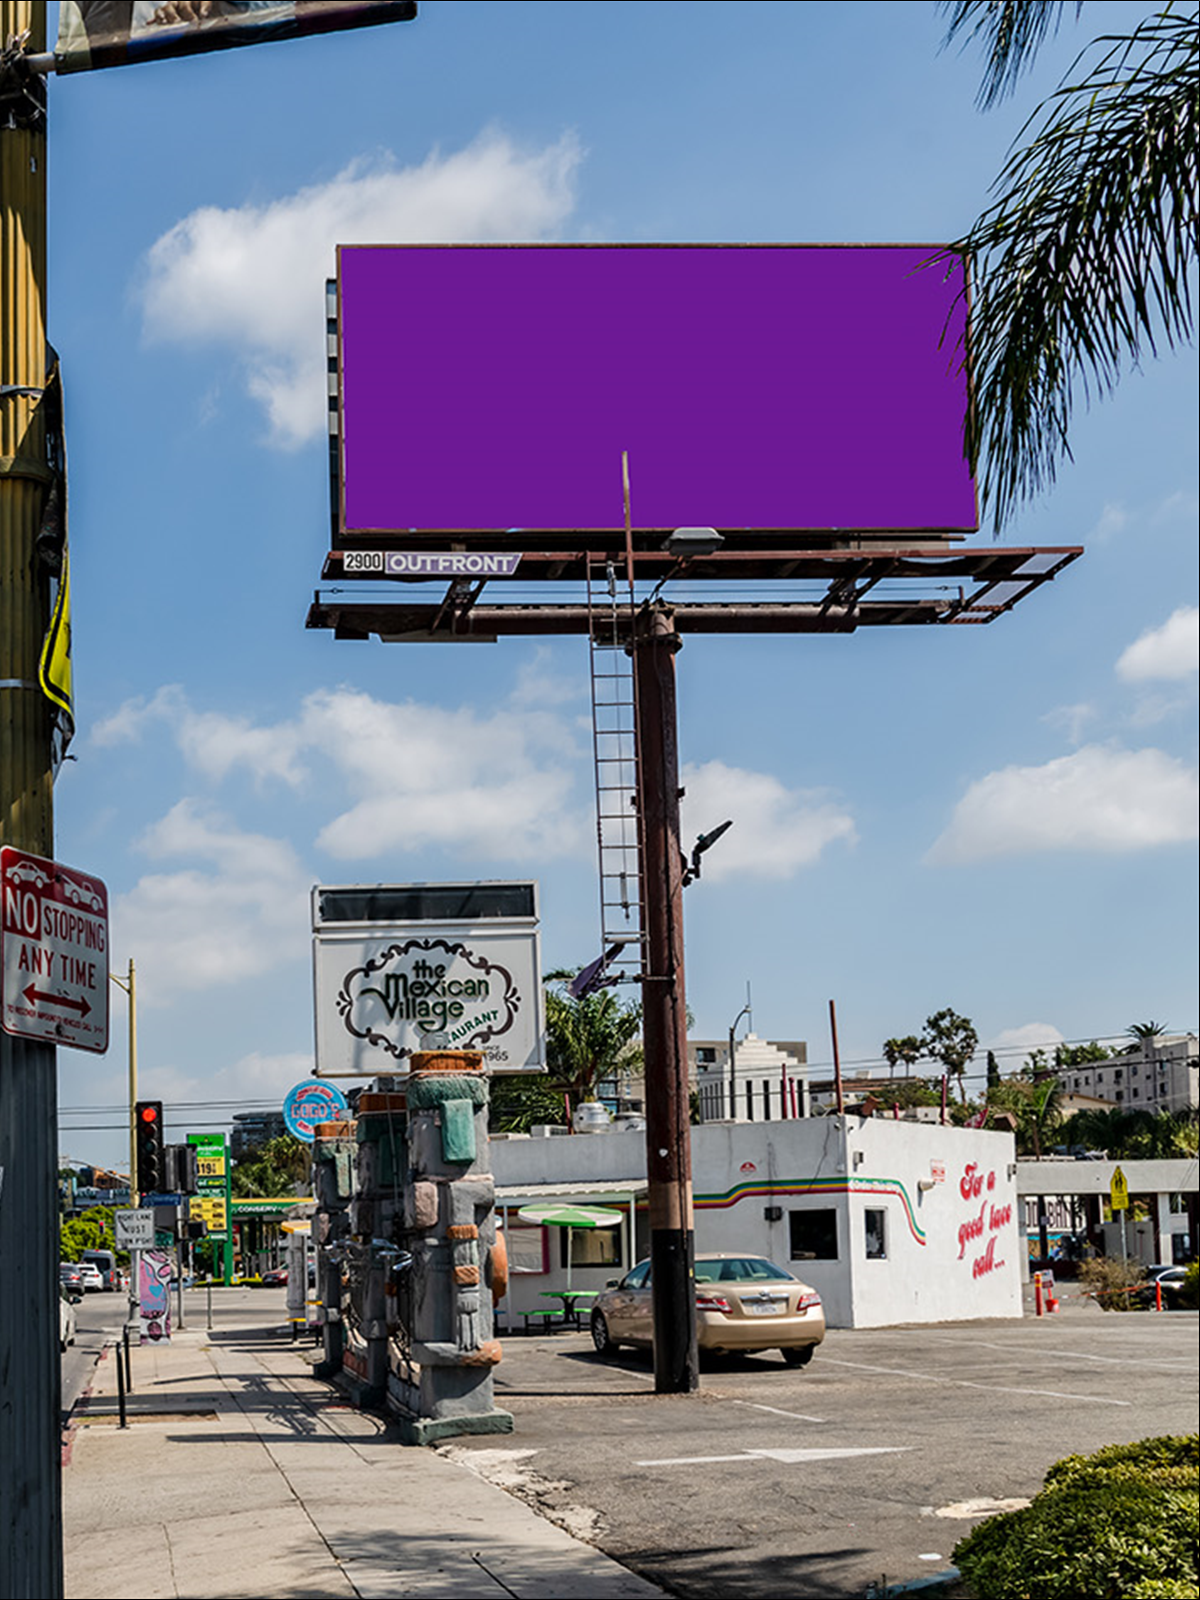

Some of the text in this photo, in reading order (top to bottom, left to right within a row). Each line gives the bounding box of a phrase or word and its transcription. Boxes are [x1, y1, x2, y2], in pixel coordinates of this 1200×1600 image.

[345, 553, 515, 572] 2900 OUTFRONT
[6, 887, 105, 952] NO STOPPING
[18, 943, 97, 990] ANY TIME
[412, 959, 446, 979] the
[384, 973, 490, 1000] Mexican
[359, 988, 465, 1033] Village
[448, 1010, 500, 1044] AURANT
[486, 1051, 509, 1062] 965
[958, 1199, 987, 1260] good
